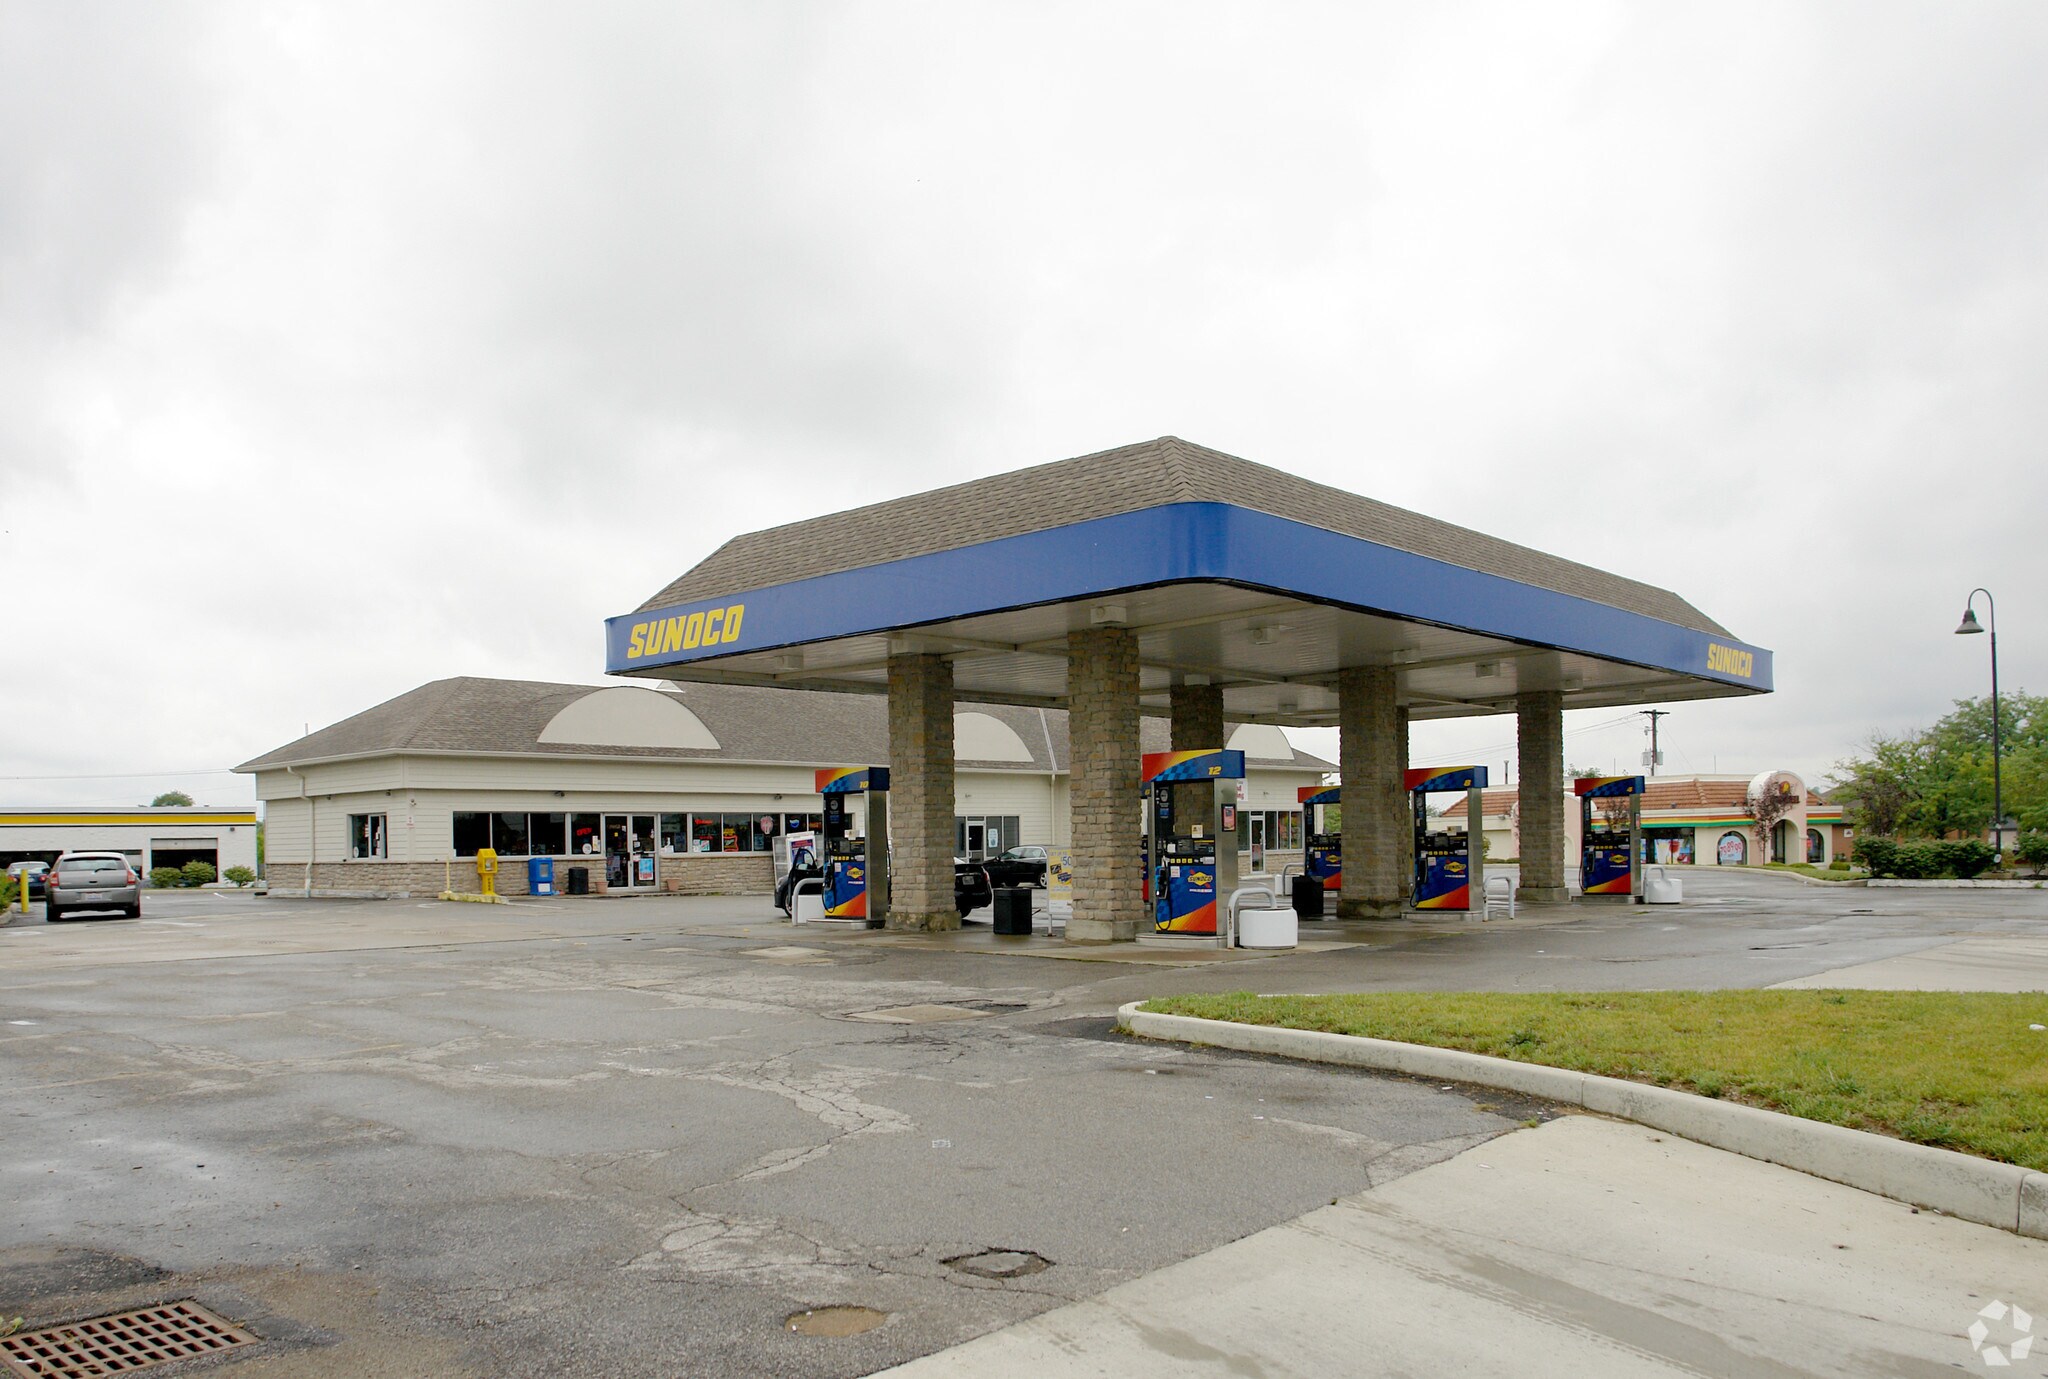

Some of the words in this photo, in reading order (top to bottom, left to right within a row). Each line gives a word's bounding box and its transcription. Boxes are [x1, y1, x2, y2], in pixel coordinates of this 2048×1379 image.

[627, 604, 745, 659] SUNOCO
[1707, 643, 1754, 678] SUNOCO
[1208, 766, 1222, 775] 12
[859, 780, 869, 789] 10
